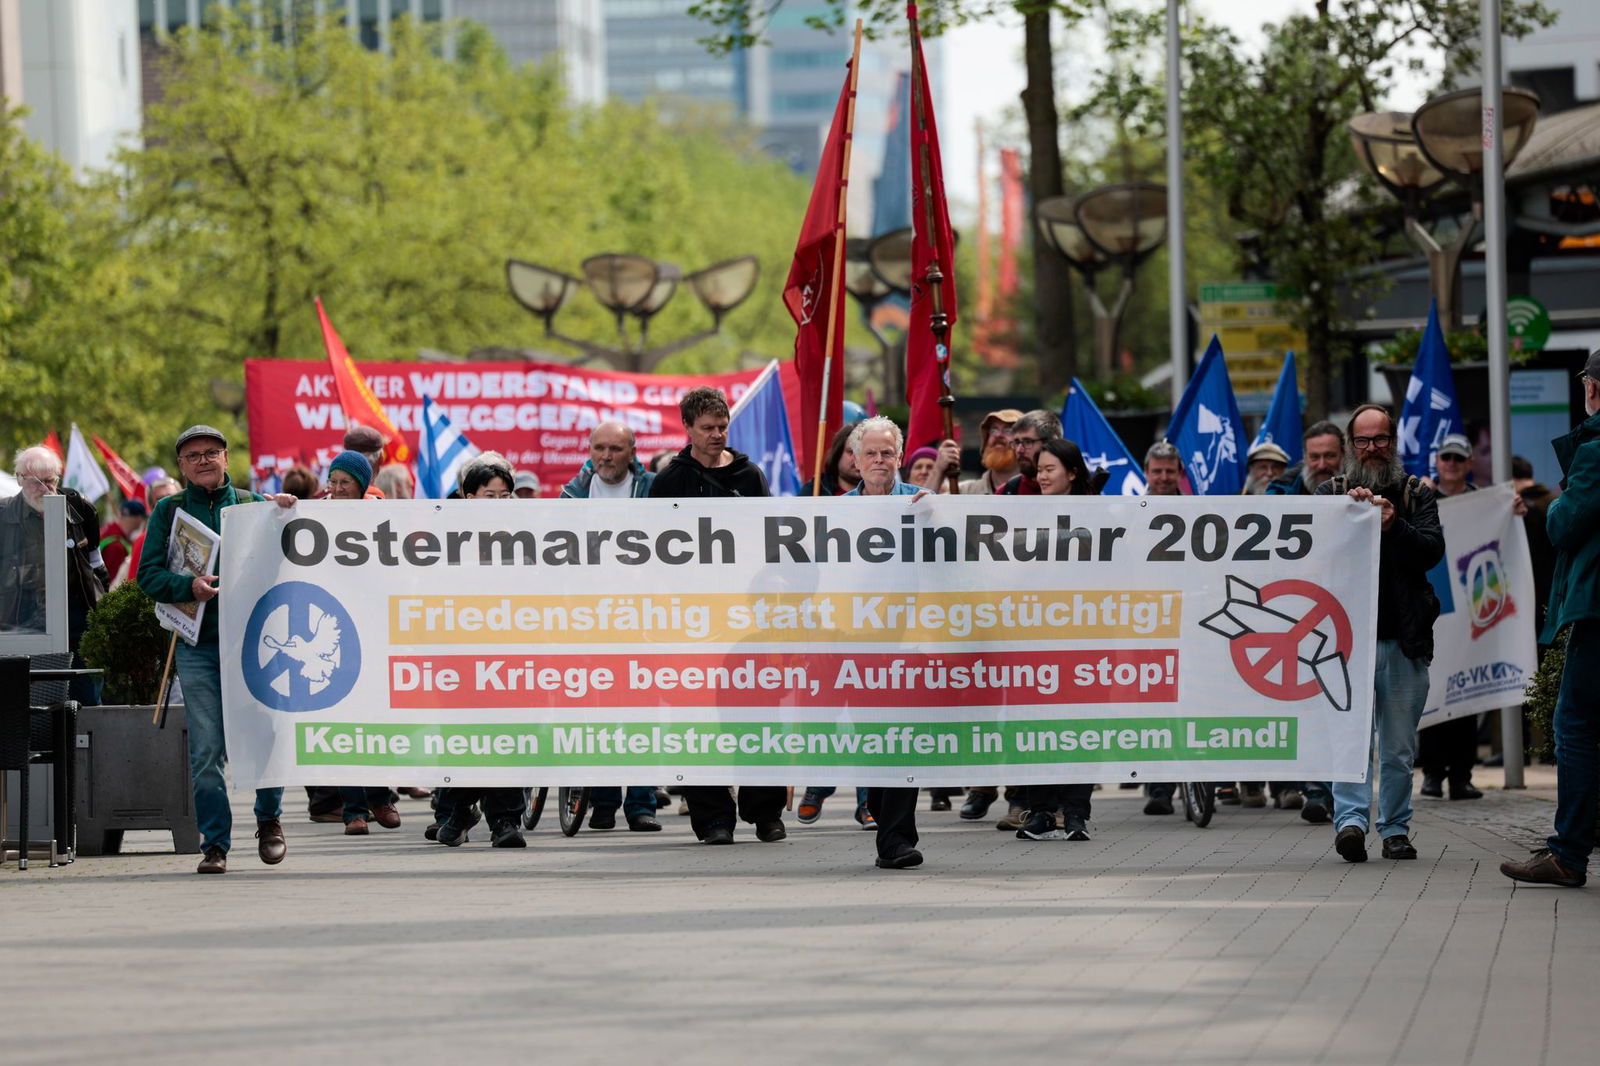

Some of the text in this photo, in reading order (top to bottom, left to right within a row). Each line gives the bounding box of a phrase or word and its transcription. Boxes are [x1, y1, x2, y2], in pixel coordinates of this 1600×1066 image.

[295, 374, 406, 399] AKER
[409, 370, 638, 405] WIDERSTAND
[281, 513, 1314, 566] Ostermarsch RheinRuhr 2025
[398, 594, 1174, 638] Friedensfähig statt Kriegstüchtig!
[393, 655, 1176, 698] Die Kriege beenden, Aufrüstung stop!
[304, 720, 1290, 756] Keine neuen Mittelstreckenwaffen in unserem Land!
